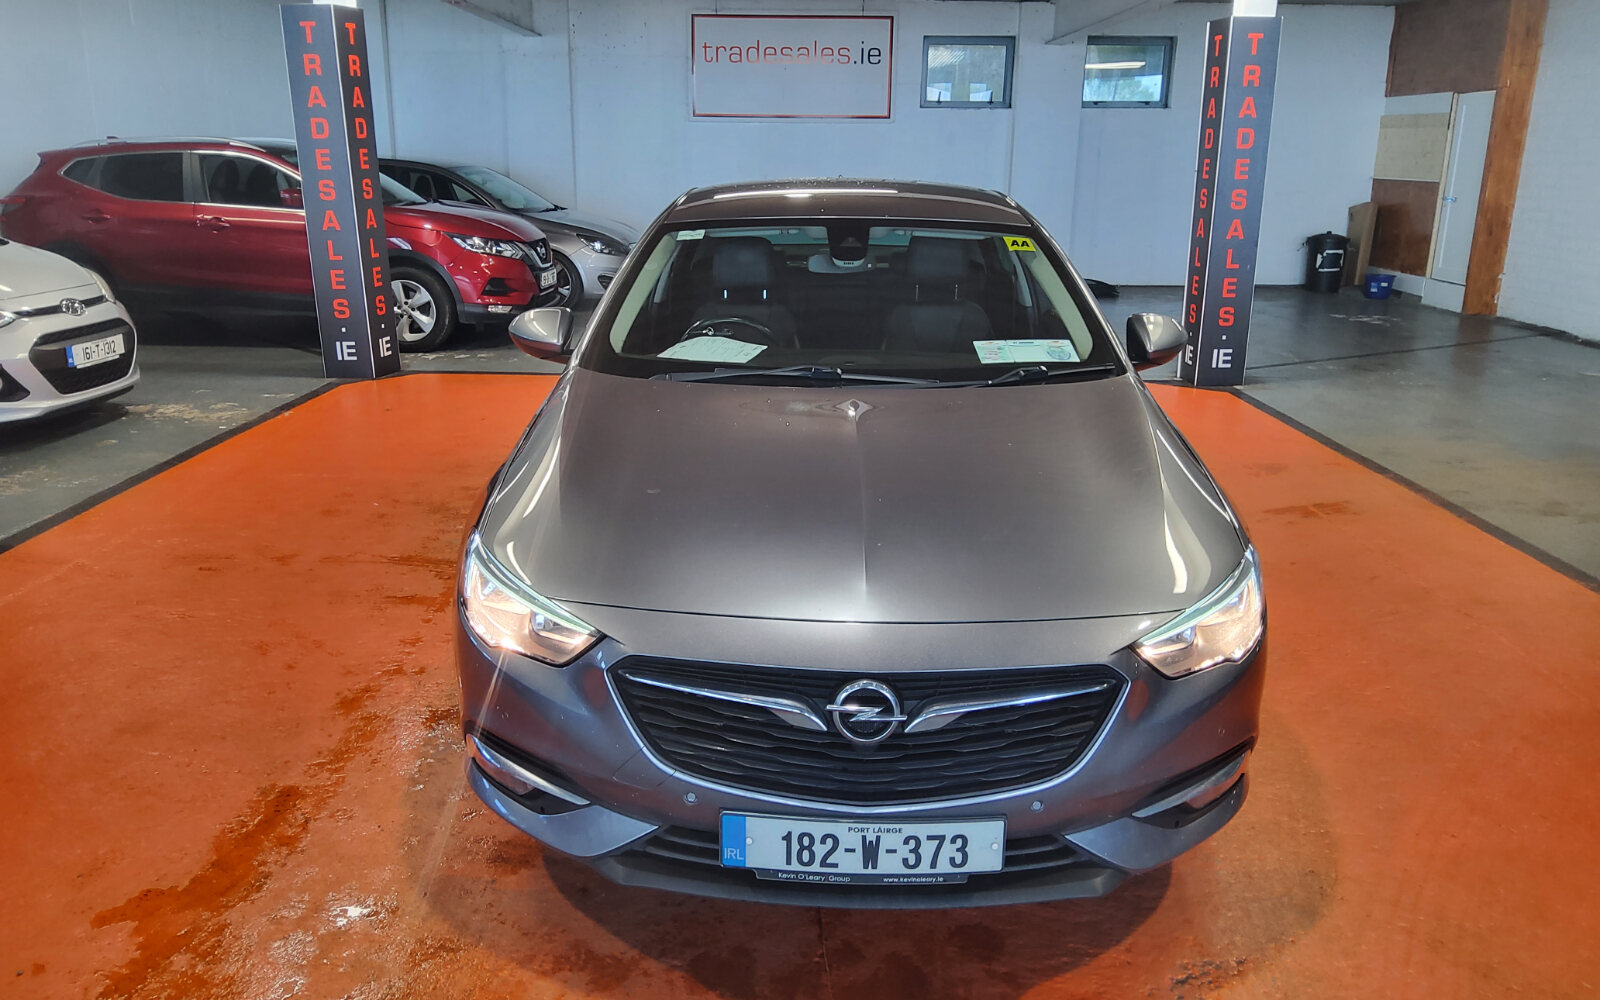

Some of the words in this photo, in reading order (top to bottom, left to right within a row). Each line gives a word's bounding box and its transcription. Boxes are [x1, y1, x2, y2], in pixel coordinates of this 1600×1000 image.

[702, 40, 882, 65] tradesales.ie
[1010, 240, 1030, 248] AA
[82, 340, 117, 361] 161-T-1312
[847, 826, 870, 834] PORT
[872, 826, 903, 834] LÁIRGE
[724, 847, 745, 861] IRL
[781, 830, 969, 870] 182-W-373
[797, 873, 825, 882] O'Leary
[828, 875, 851, 883] Group
